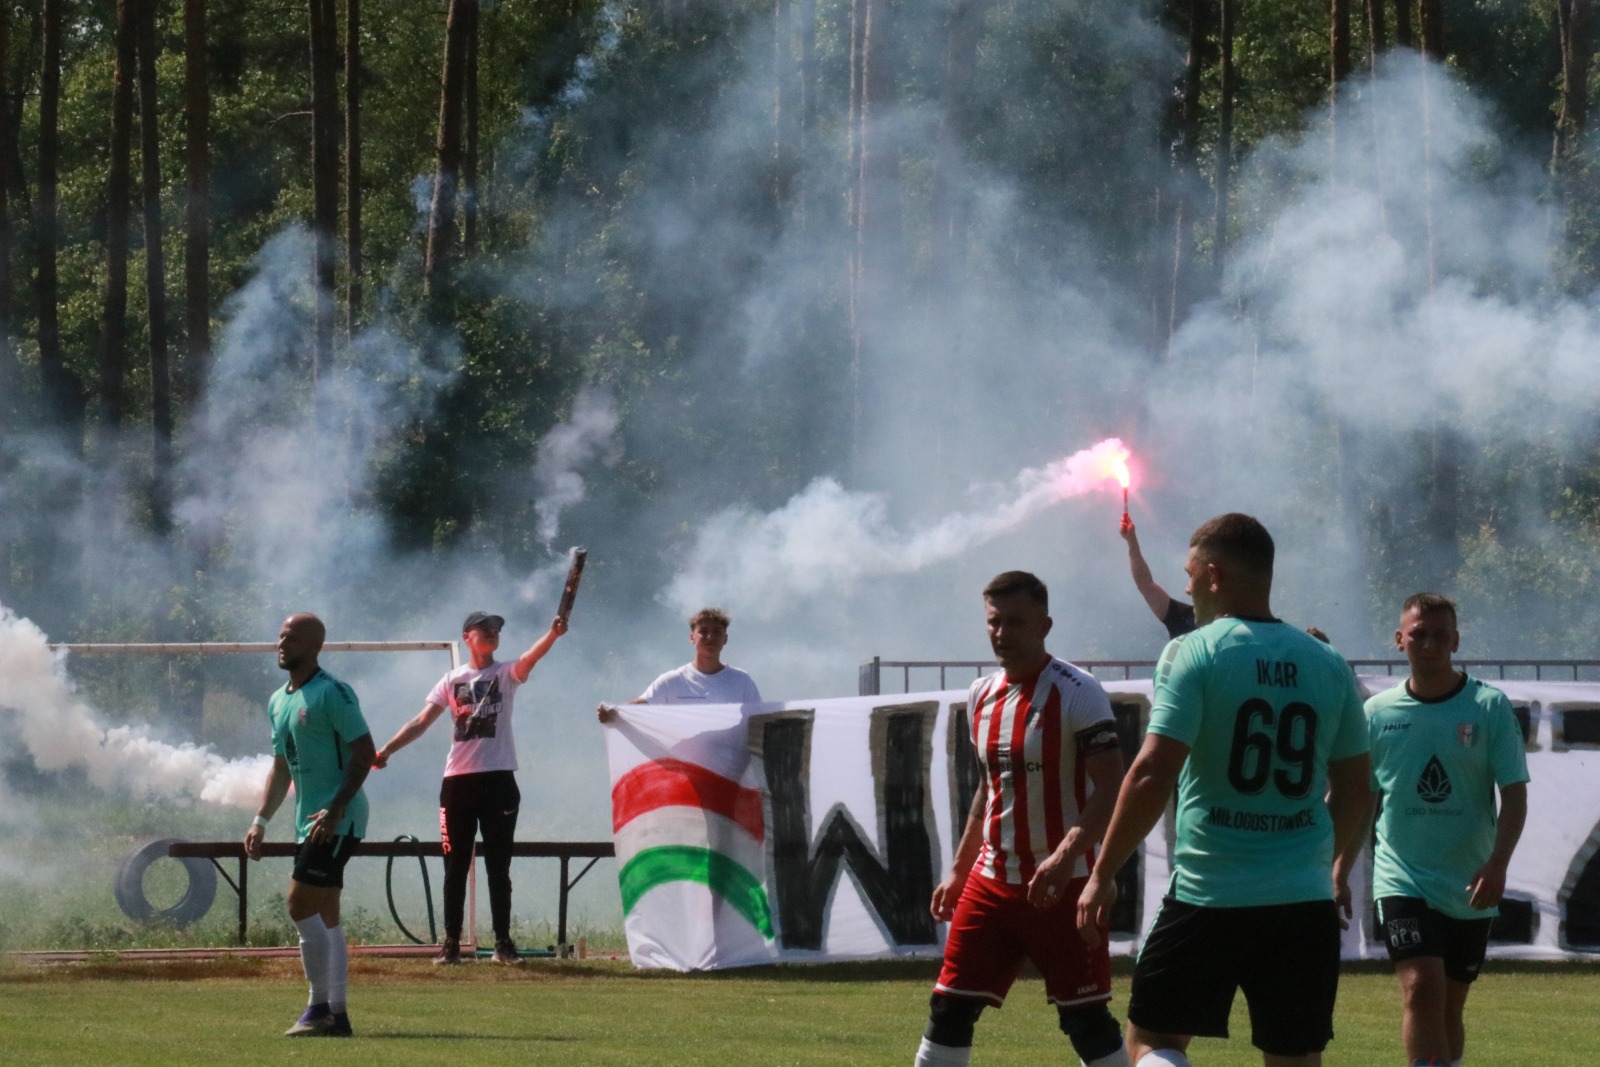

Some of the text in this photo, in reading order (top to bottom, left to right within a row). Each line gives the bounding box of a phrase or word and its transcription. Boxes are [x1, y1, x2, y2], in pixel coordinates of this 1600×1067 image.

[1257, 659, 1297, 688] IKAR
[1228, 698, 1318, 800] 69
[1404, 807, 1426, 816] CBD
[1077, 984, 1098, 994] JAKO
